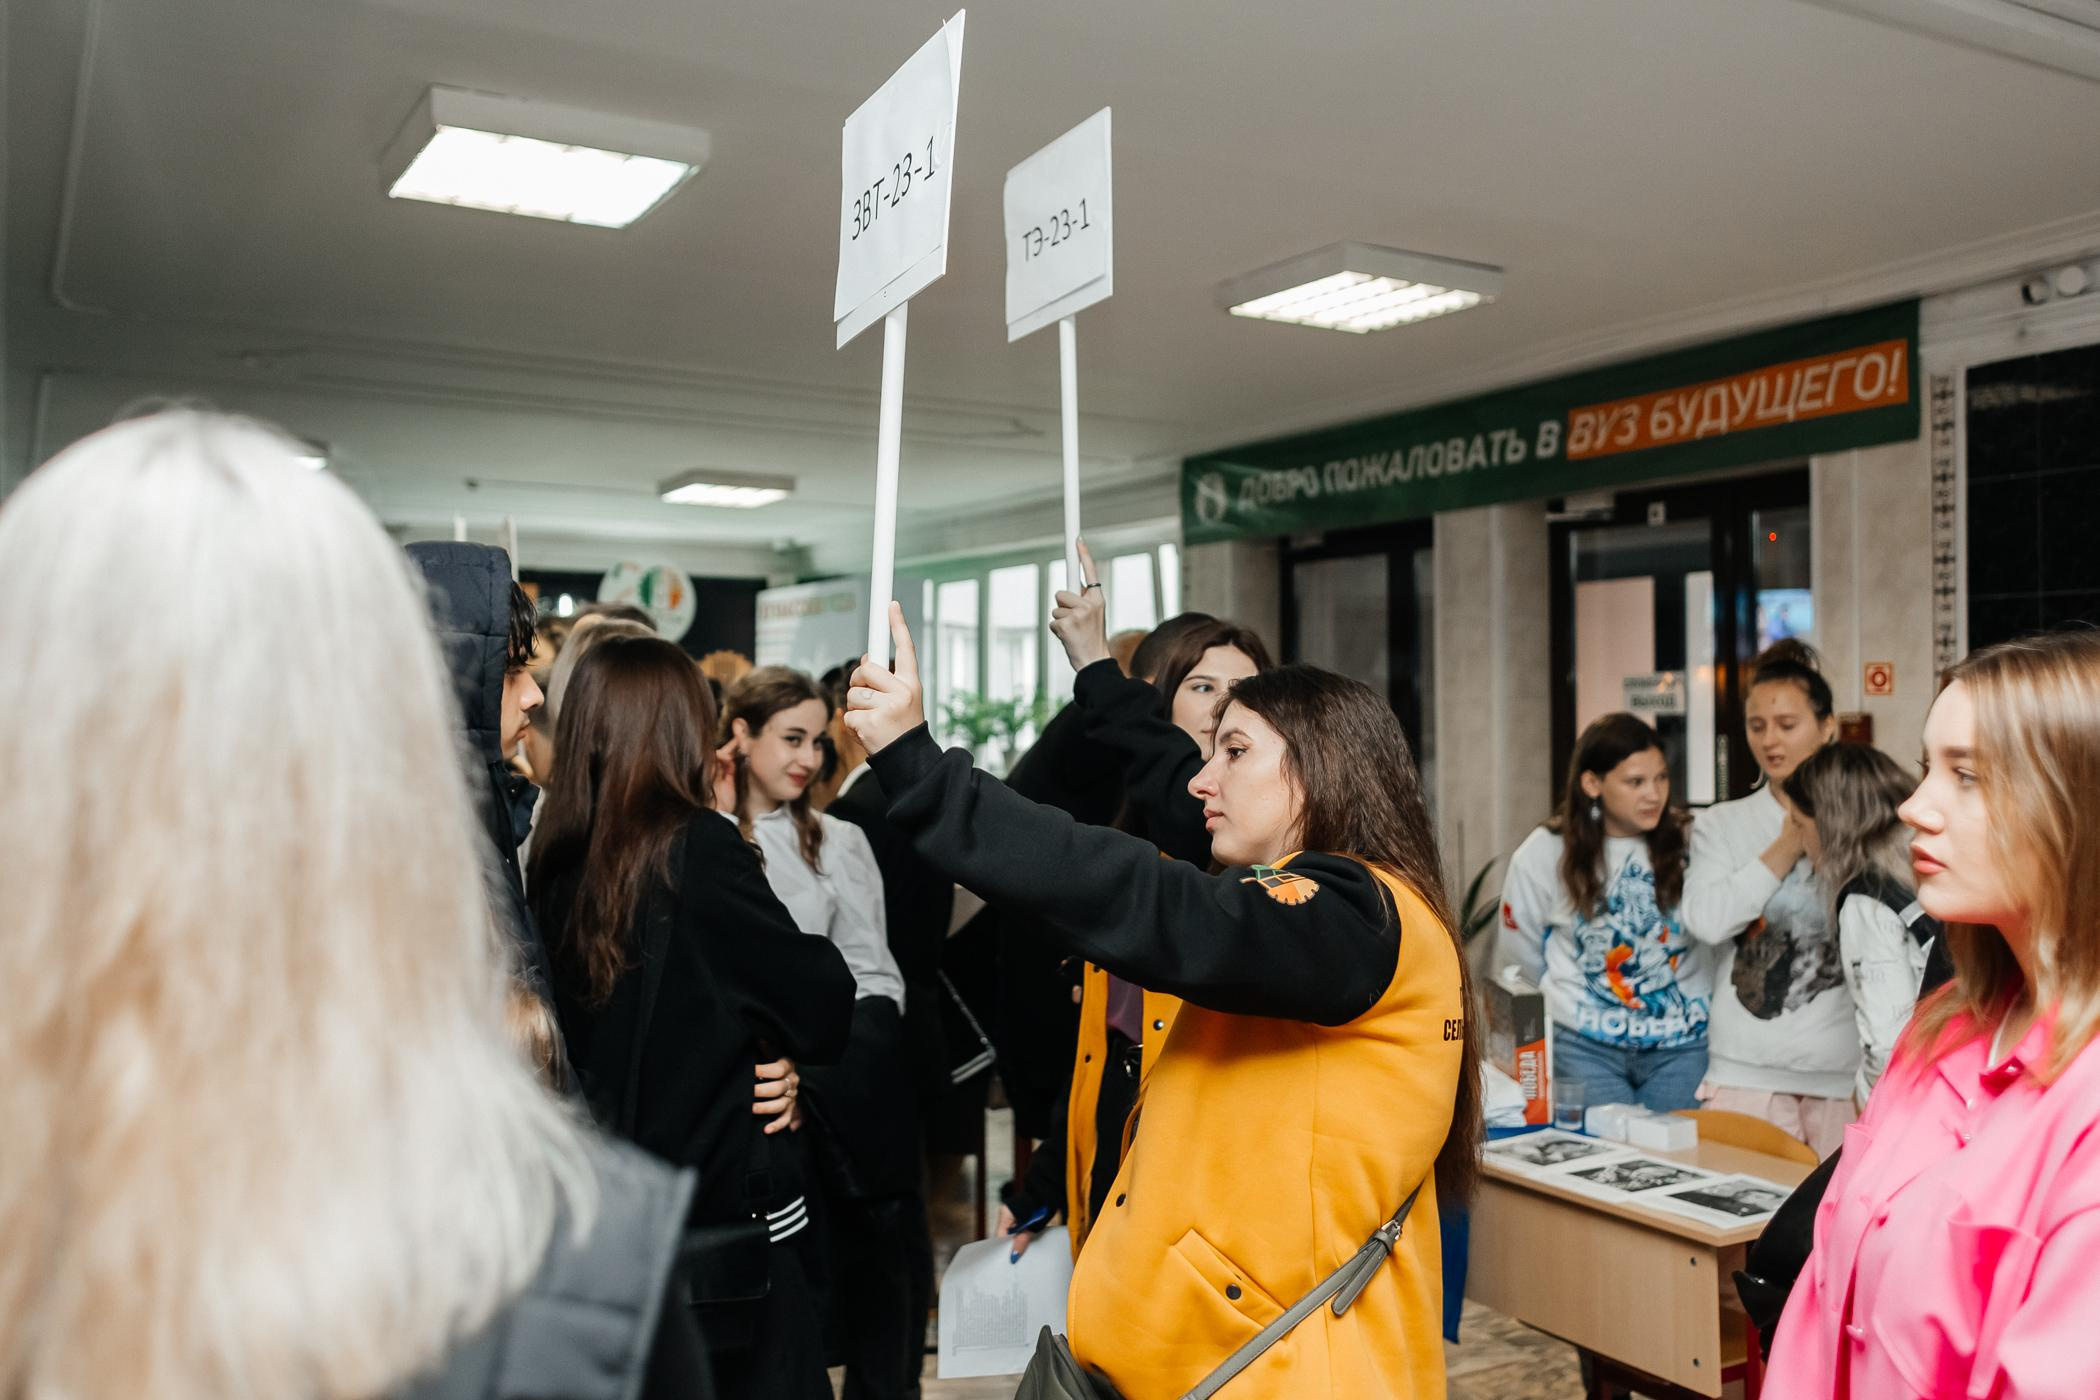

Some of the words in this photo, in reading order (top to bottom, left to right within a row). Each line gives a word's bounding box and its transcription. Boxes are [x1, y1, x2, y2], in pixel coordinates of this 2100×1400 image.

[1022, 197, 1090, 262] ТЭ-23-1
[1237, 465, 1319, 512] ДОБРО
[1323, 427, 1528, 494] ПОЖАЛОВАТЬ
[1535, 419, 1562, 459] В
[1568, 402, 1642, 455] ВУЗ
[1649, 347, 1904, 440] БУДУЩЕГО!
